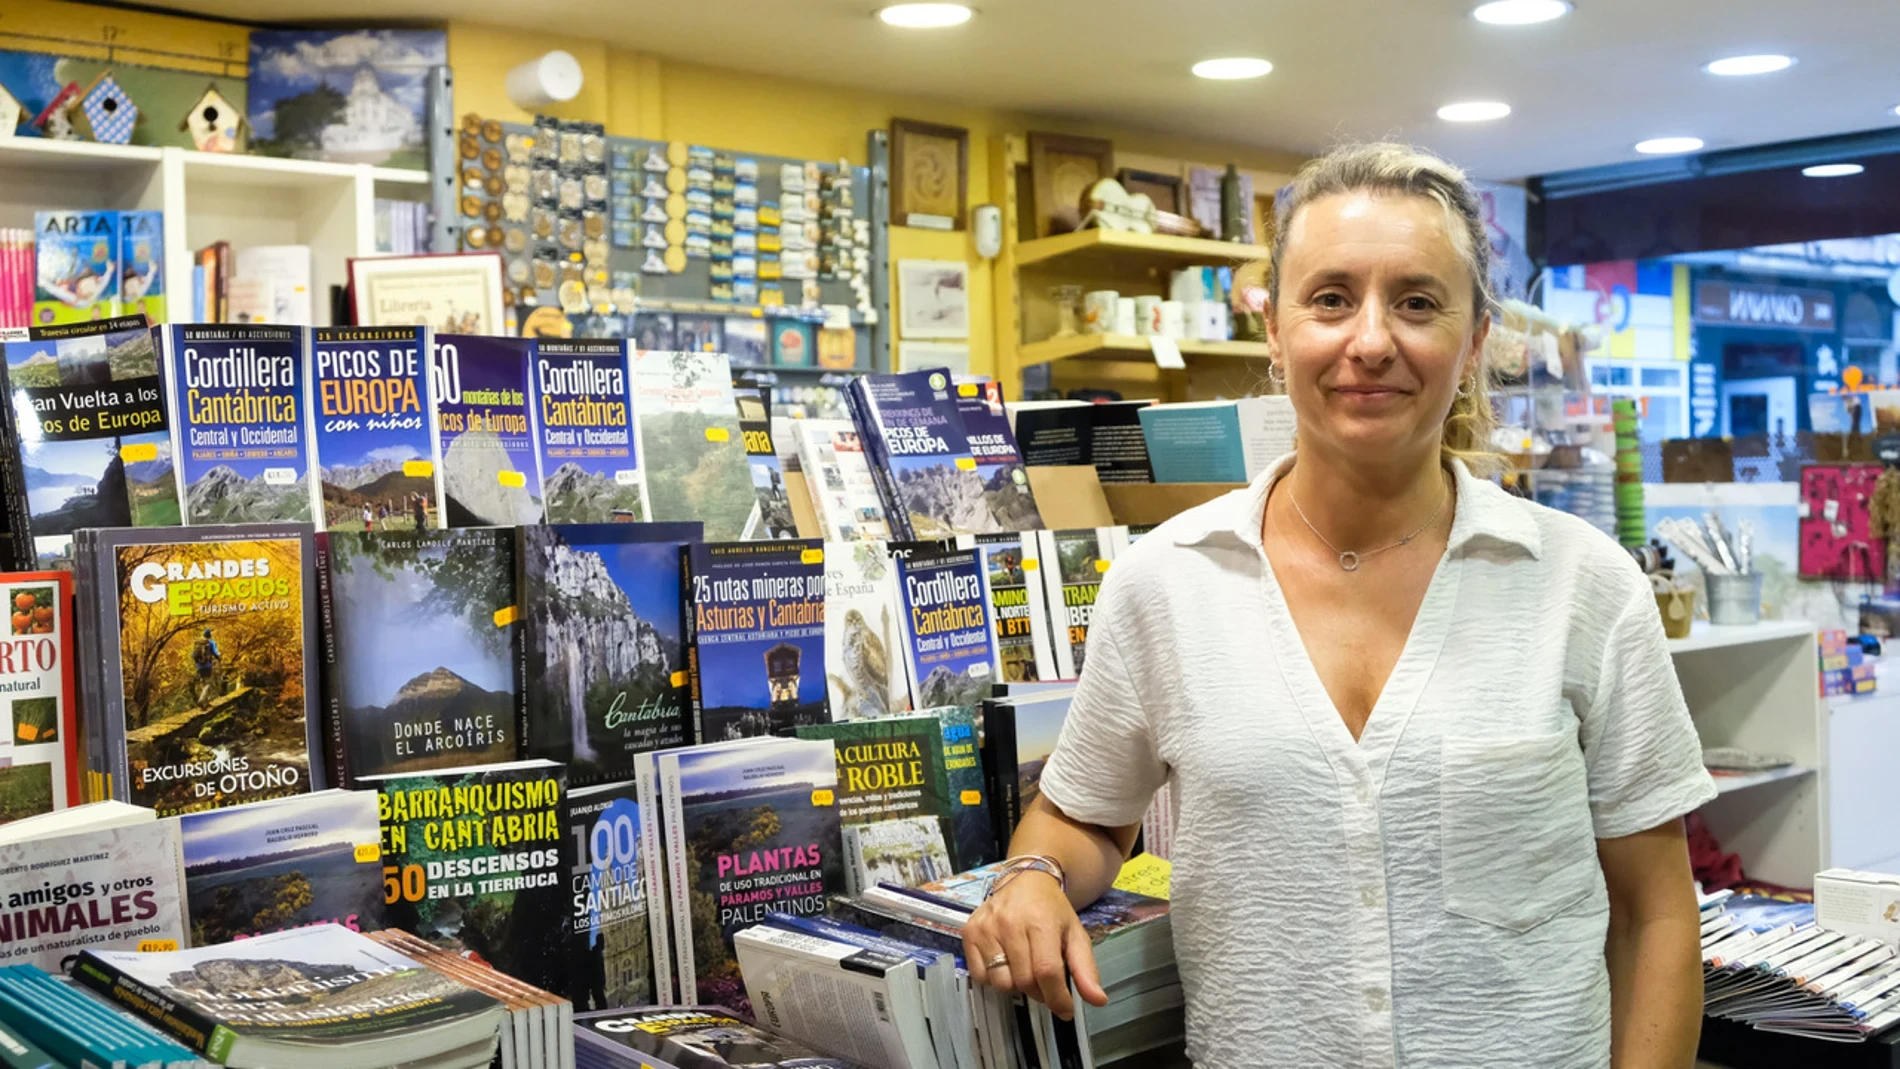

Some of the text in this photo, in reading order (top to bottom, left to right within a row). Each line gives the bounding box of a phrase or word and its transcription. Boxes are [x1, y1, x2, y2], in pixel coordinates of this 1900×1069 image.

[338, 330, 415, 341] EXCURSIONES
[184, 347, 295, 388] Cordillera
[317, 349, 419, 378] PICOS DE
[538, 359, 624, 395] Cordillera
[60, 387, 158, 409] Vuelta a los
[187, 388, 297, 425] Cantábrica
[320, 378, 422, 416] EUROPA
[462, 388, 525, 406] montañas de los
[987, 388, 1003, 410] 2
[69, 414, 90, 432] de
[98, 408, 162, 430] Europa
[325, 412, 422, 432] con niños
[467, 408, 528, 436] de Europa
[542, 394, 627, 426] Cantábrica
[910, 414, 949, 427] SEMANA
[190, 426, 298, 447] Central y Occidental
[545, 428, 629, 447] Central y Occidental
[884, 426, 930, 440] PICOS DE
[887, 436, 950, 455] EUROPA
[993, 433, 1006, 445] DE
[969, 444, 1016, 456] DE EUROPA
[381, 539, 412, 549] CARLOS
[456, 534, 496, 546] MARTÍNEZ
[130, 558, 270, 603] GRANDES
[693, 574, 711, 604] 25
[713, 577, 750, 603] rutas
[752, 571, 804, 601] mineras
[836, 582, 875, 599] España
[906, 570, 980, 608] Cordillera
[168, 578, 289, 616] ESPACIOS
[200, 600, 289, 614] TURISMO ACTIVO
[696, 597, 825, 632] Asturias y Cantabria
[912, 601, 984, 636] Cantábrica
[1001, 605, 1030, 619] NORTE
[1008, 617, 1031, 635] BTT
[1069, 626, 1085, 643] EN
[916, 634, 943, 652] Central
[950, 627, 987, 647] Occidental
[0, 676, 41, 693] natural
[394, 714, 494, 739] DONDE NACE
[623, 729, 632, 738] la
[634, 727, 656, 738] magia
[659, 725, 668, 734] de
[943, 724, 972, 742] agua
[396, 729, 505, 755] EL ARCOÍRIS
[624, 740, 653, 750] cascadas
[845, 741, 920, 763] CULTURA
[143, 756, 250, 783] EXCURSIONES
[195, 763, 299, 798] DE OTOÑO
[846, 761, 926, 792] ROBLE
[379, 778, 559, 823] BARRANQUISMO
[570, 805, 593, 817] JUANJO
[381, 810, 561, 855] EN CANTABRIA
[571, 814, 635, 875] 100
[30, 858, 72, 871] RODRÍGUEZ
[73, 851, 110, 864] MARTÍNEZ
[717, 843, 822, 879] PLANTAS
[384, 849, 560, 905] 50 DESCENSOS
[428, 872, 560, 899] EN LA TIERRUCA
[572, 861, 637, 894] CAMINO DE
[719, 869, 822, 893] DE USO TRADICIONAL EN
[8, 875, 153, 908] amigos y otros
[574, 877, 646, 917] SANTIAGO
[720, 881, 823, 907] PÁRAMOS Y VALLES
[721, 894, 825, 926] PALENTINOS
[574, 917, 589, 930] LOS
[14, 924, 161, 957] de un naturalista de pueblo
